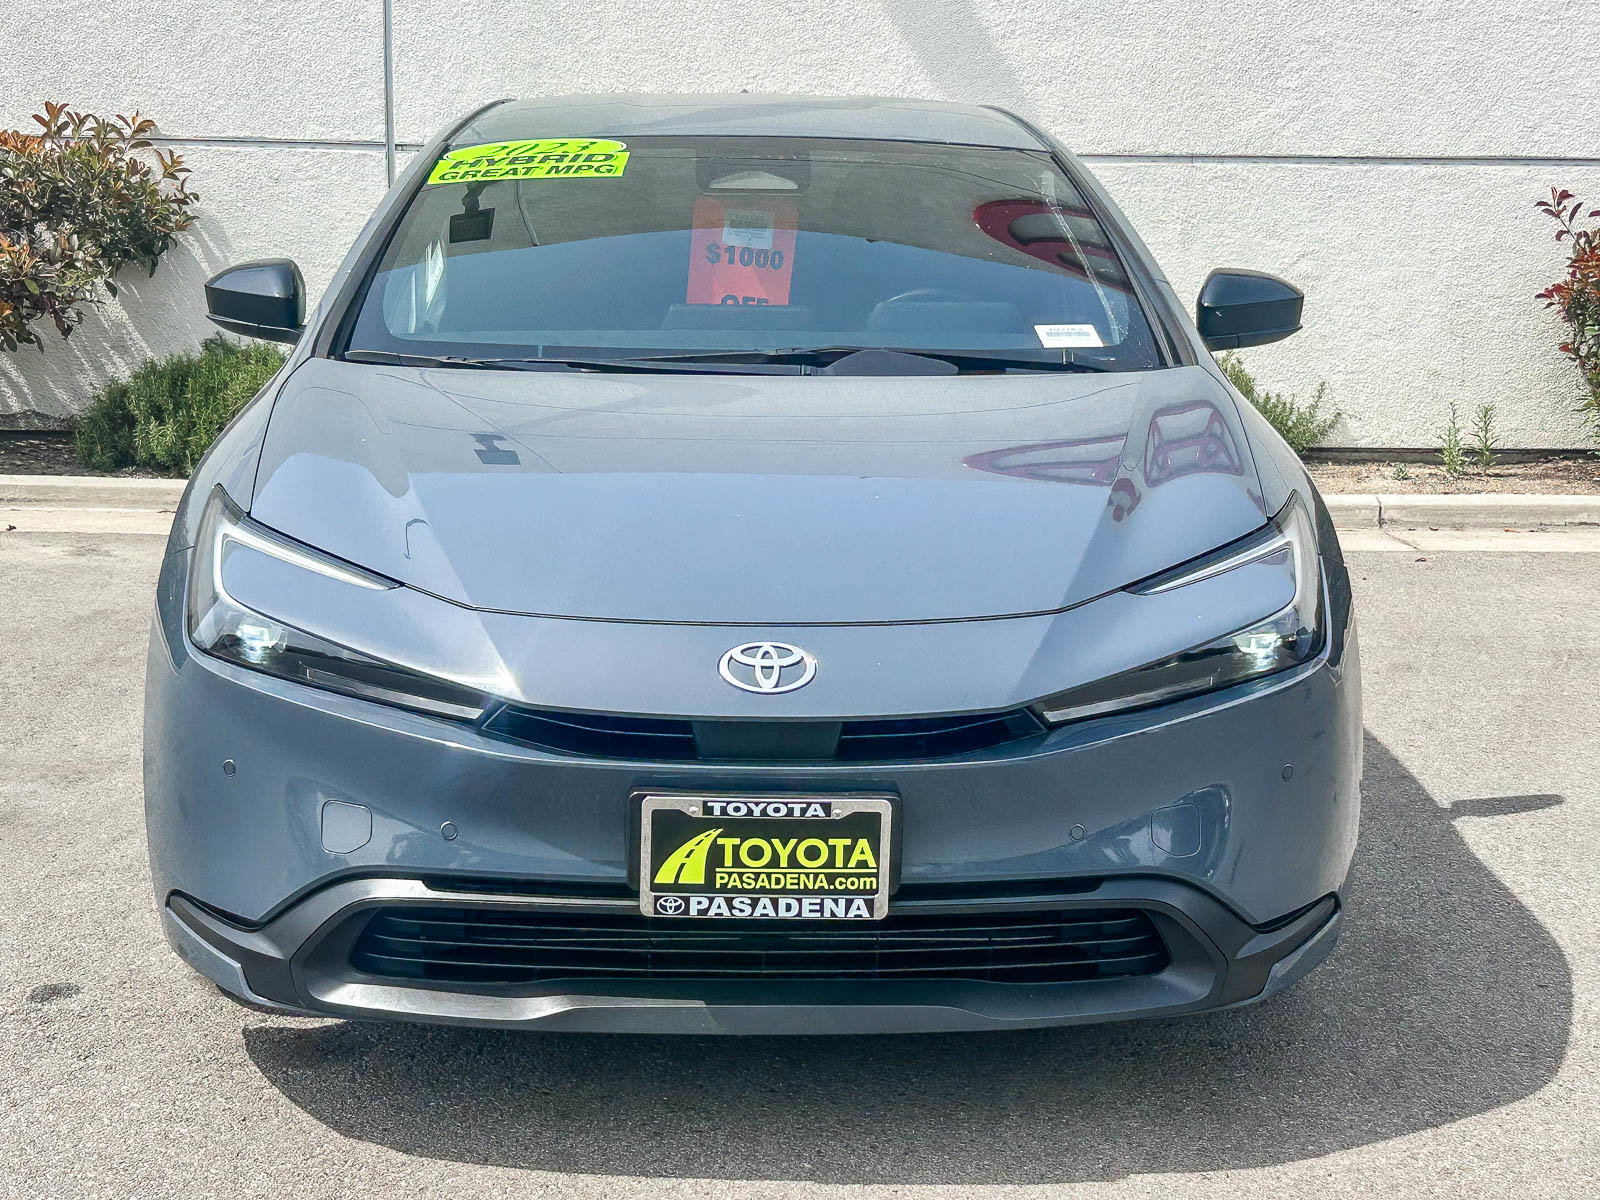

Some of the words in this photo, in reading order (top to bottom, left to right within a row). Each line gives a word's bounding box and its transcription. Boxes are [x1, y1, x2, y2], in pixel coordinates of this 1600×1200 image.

[450, 153, 614, 170] HYBRID
[438, 165, 538, 181] GREAT
[545, 164, 614, 175] MPG
[705, 242, 784, 270] $1000
[707, 801, 826, 817] TOYOTA
[716, 837, 878, 868] TOYOTA
[715, 872, 877, 890] PASADENA.com
[689, 896, 871, 918] PASADENA
